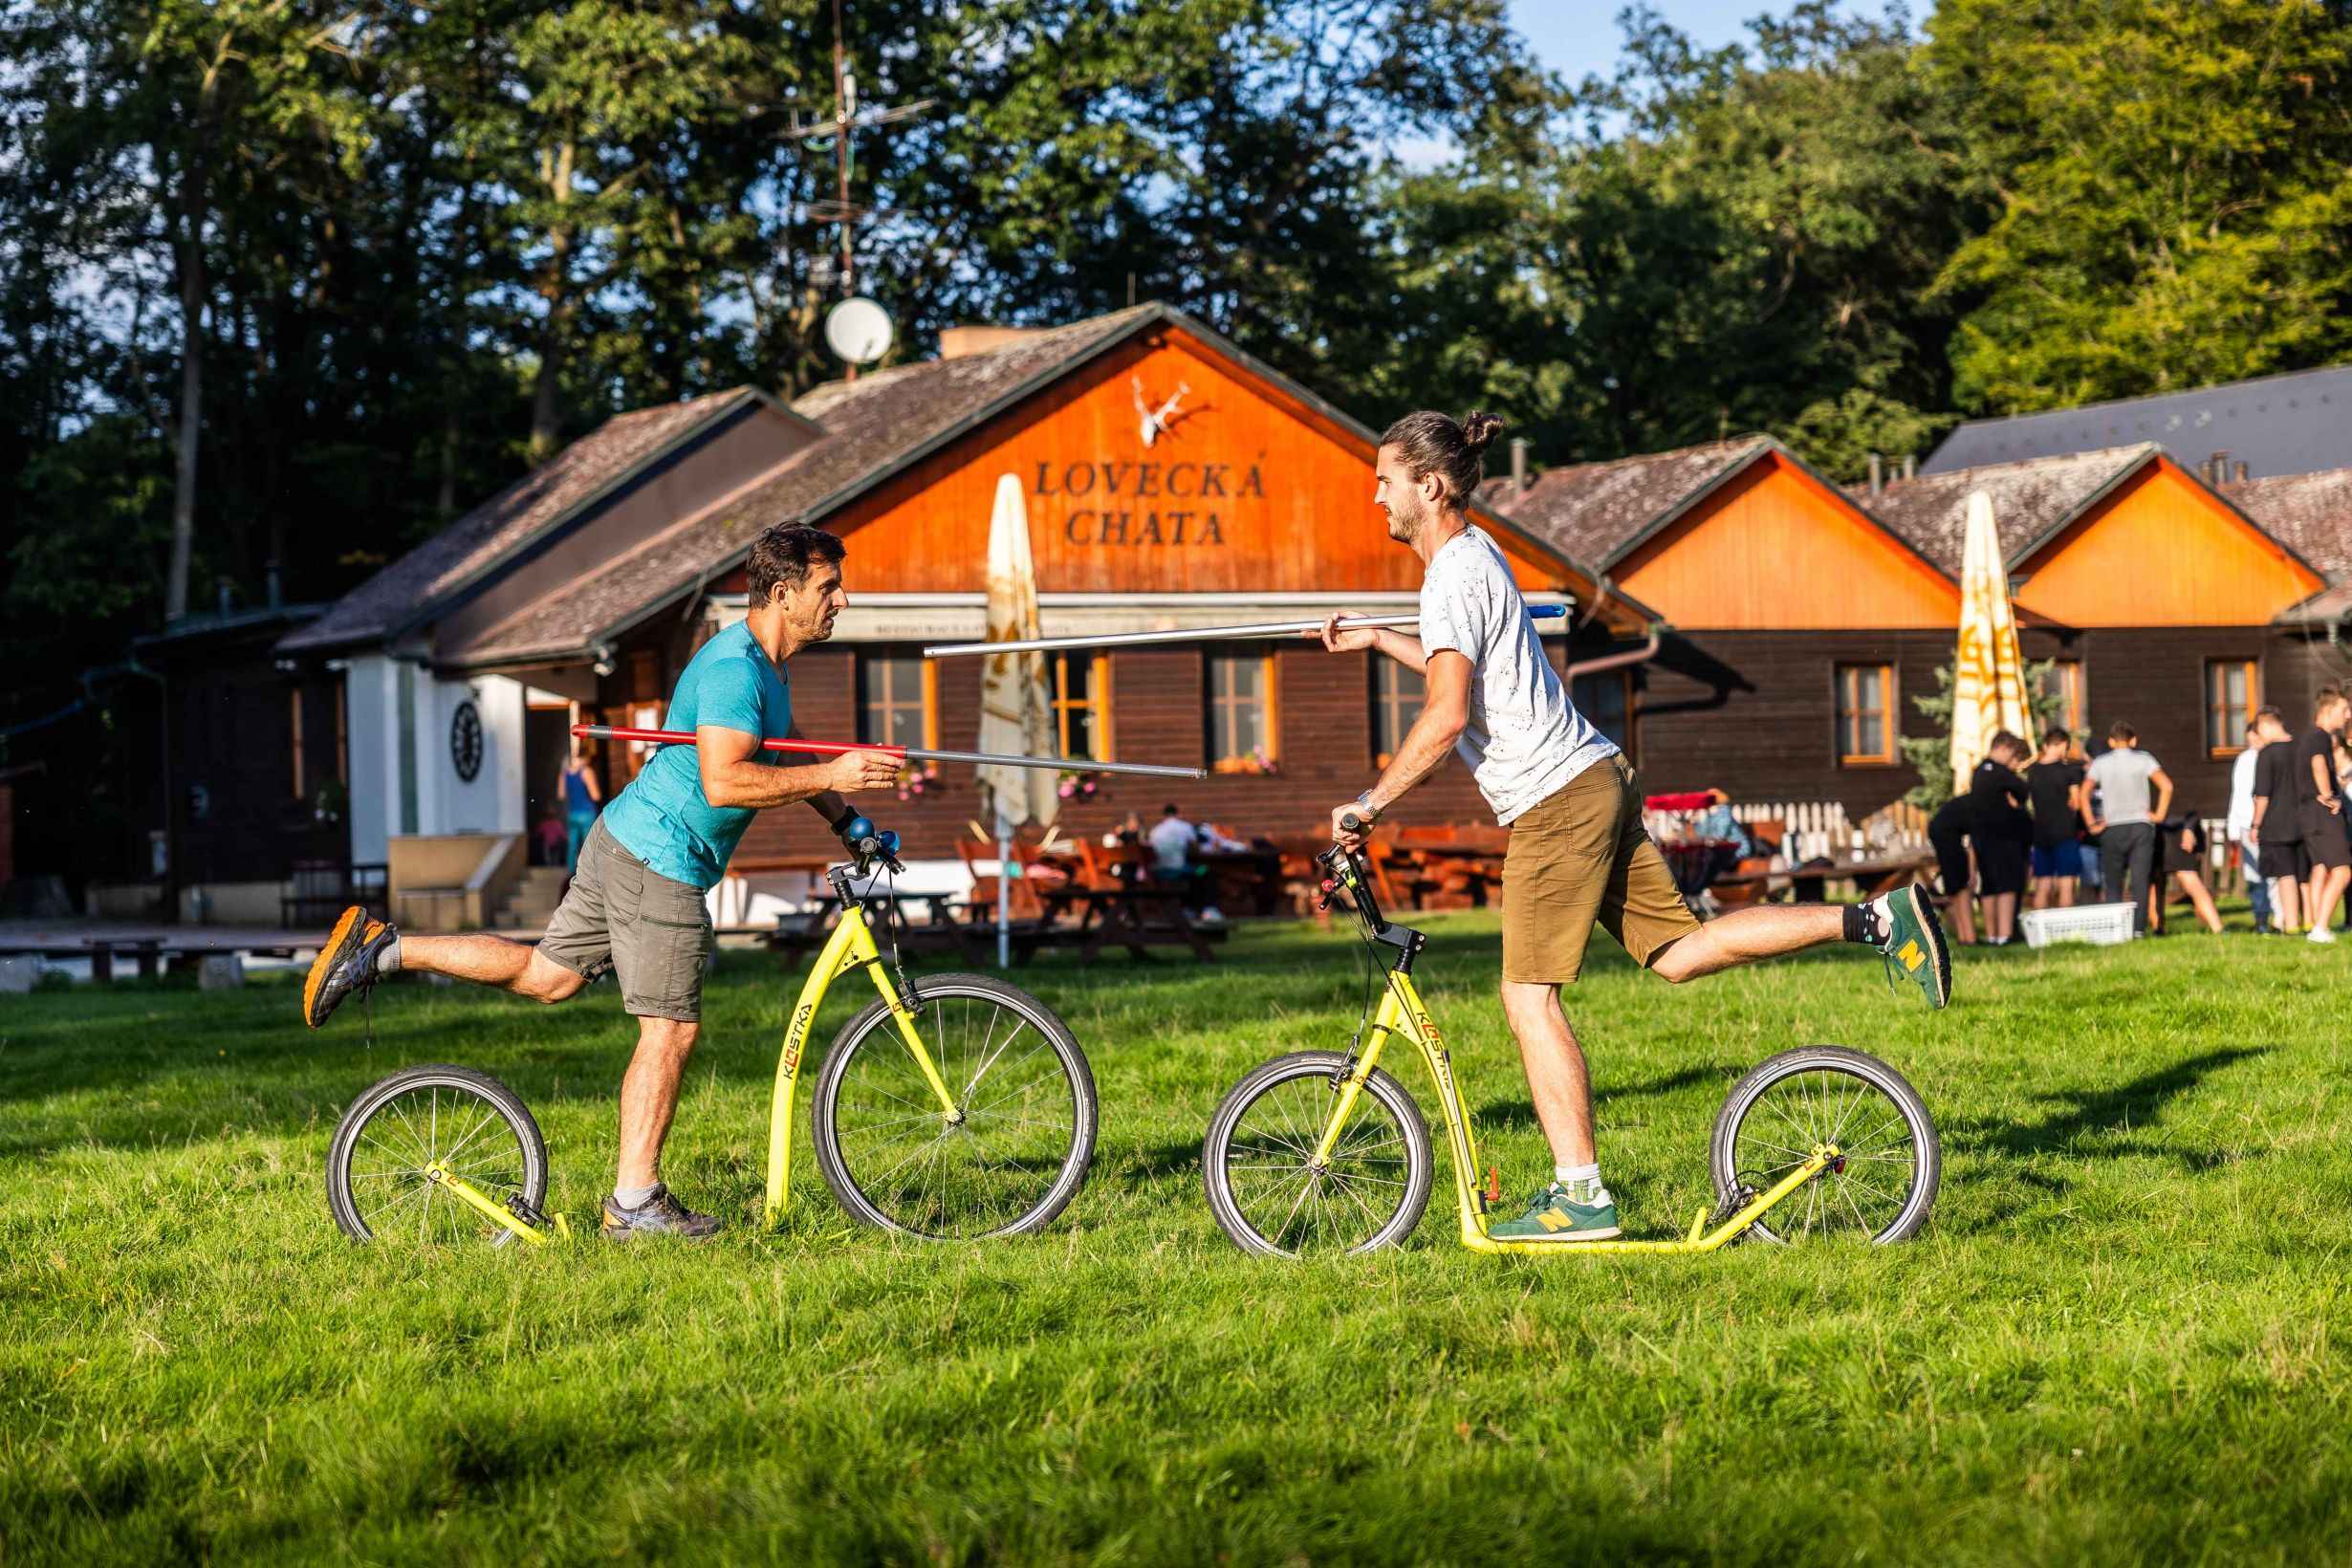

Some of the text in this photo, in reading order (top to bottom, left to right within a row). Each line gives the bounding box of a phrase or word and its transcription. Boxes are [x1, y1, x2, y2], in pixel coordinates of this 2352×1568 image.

[1065, 510, 1225, 546] CHATA
[1898, 940, 1927, 972] N
[783, 1003, 813, 1080] KOSTKA
